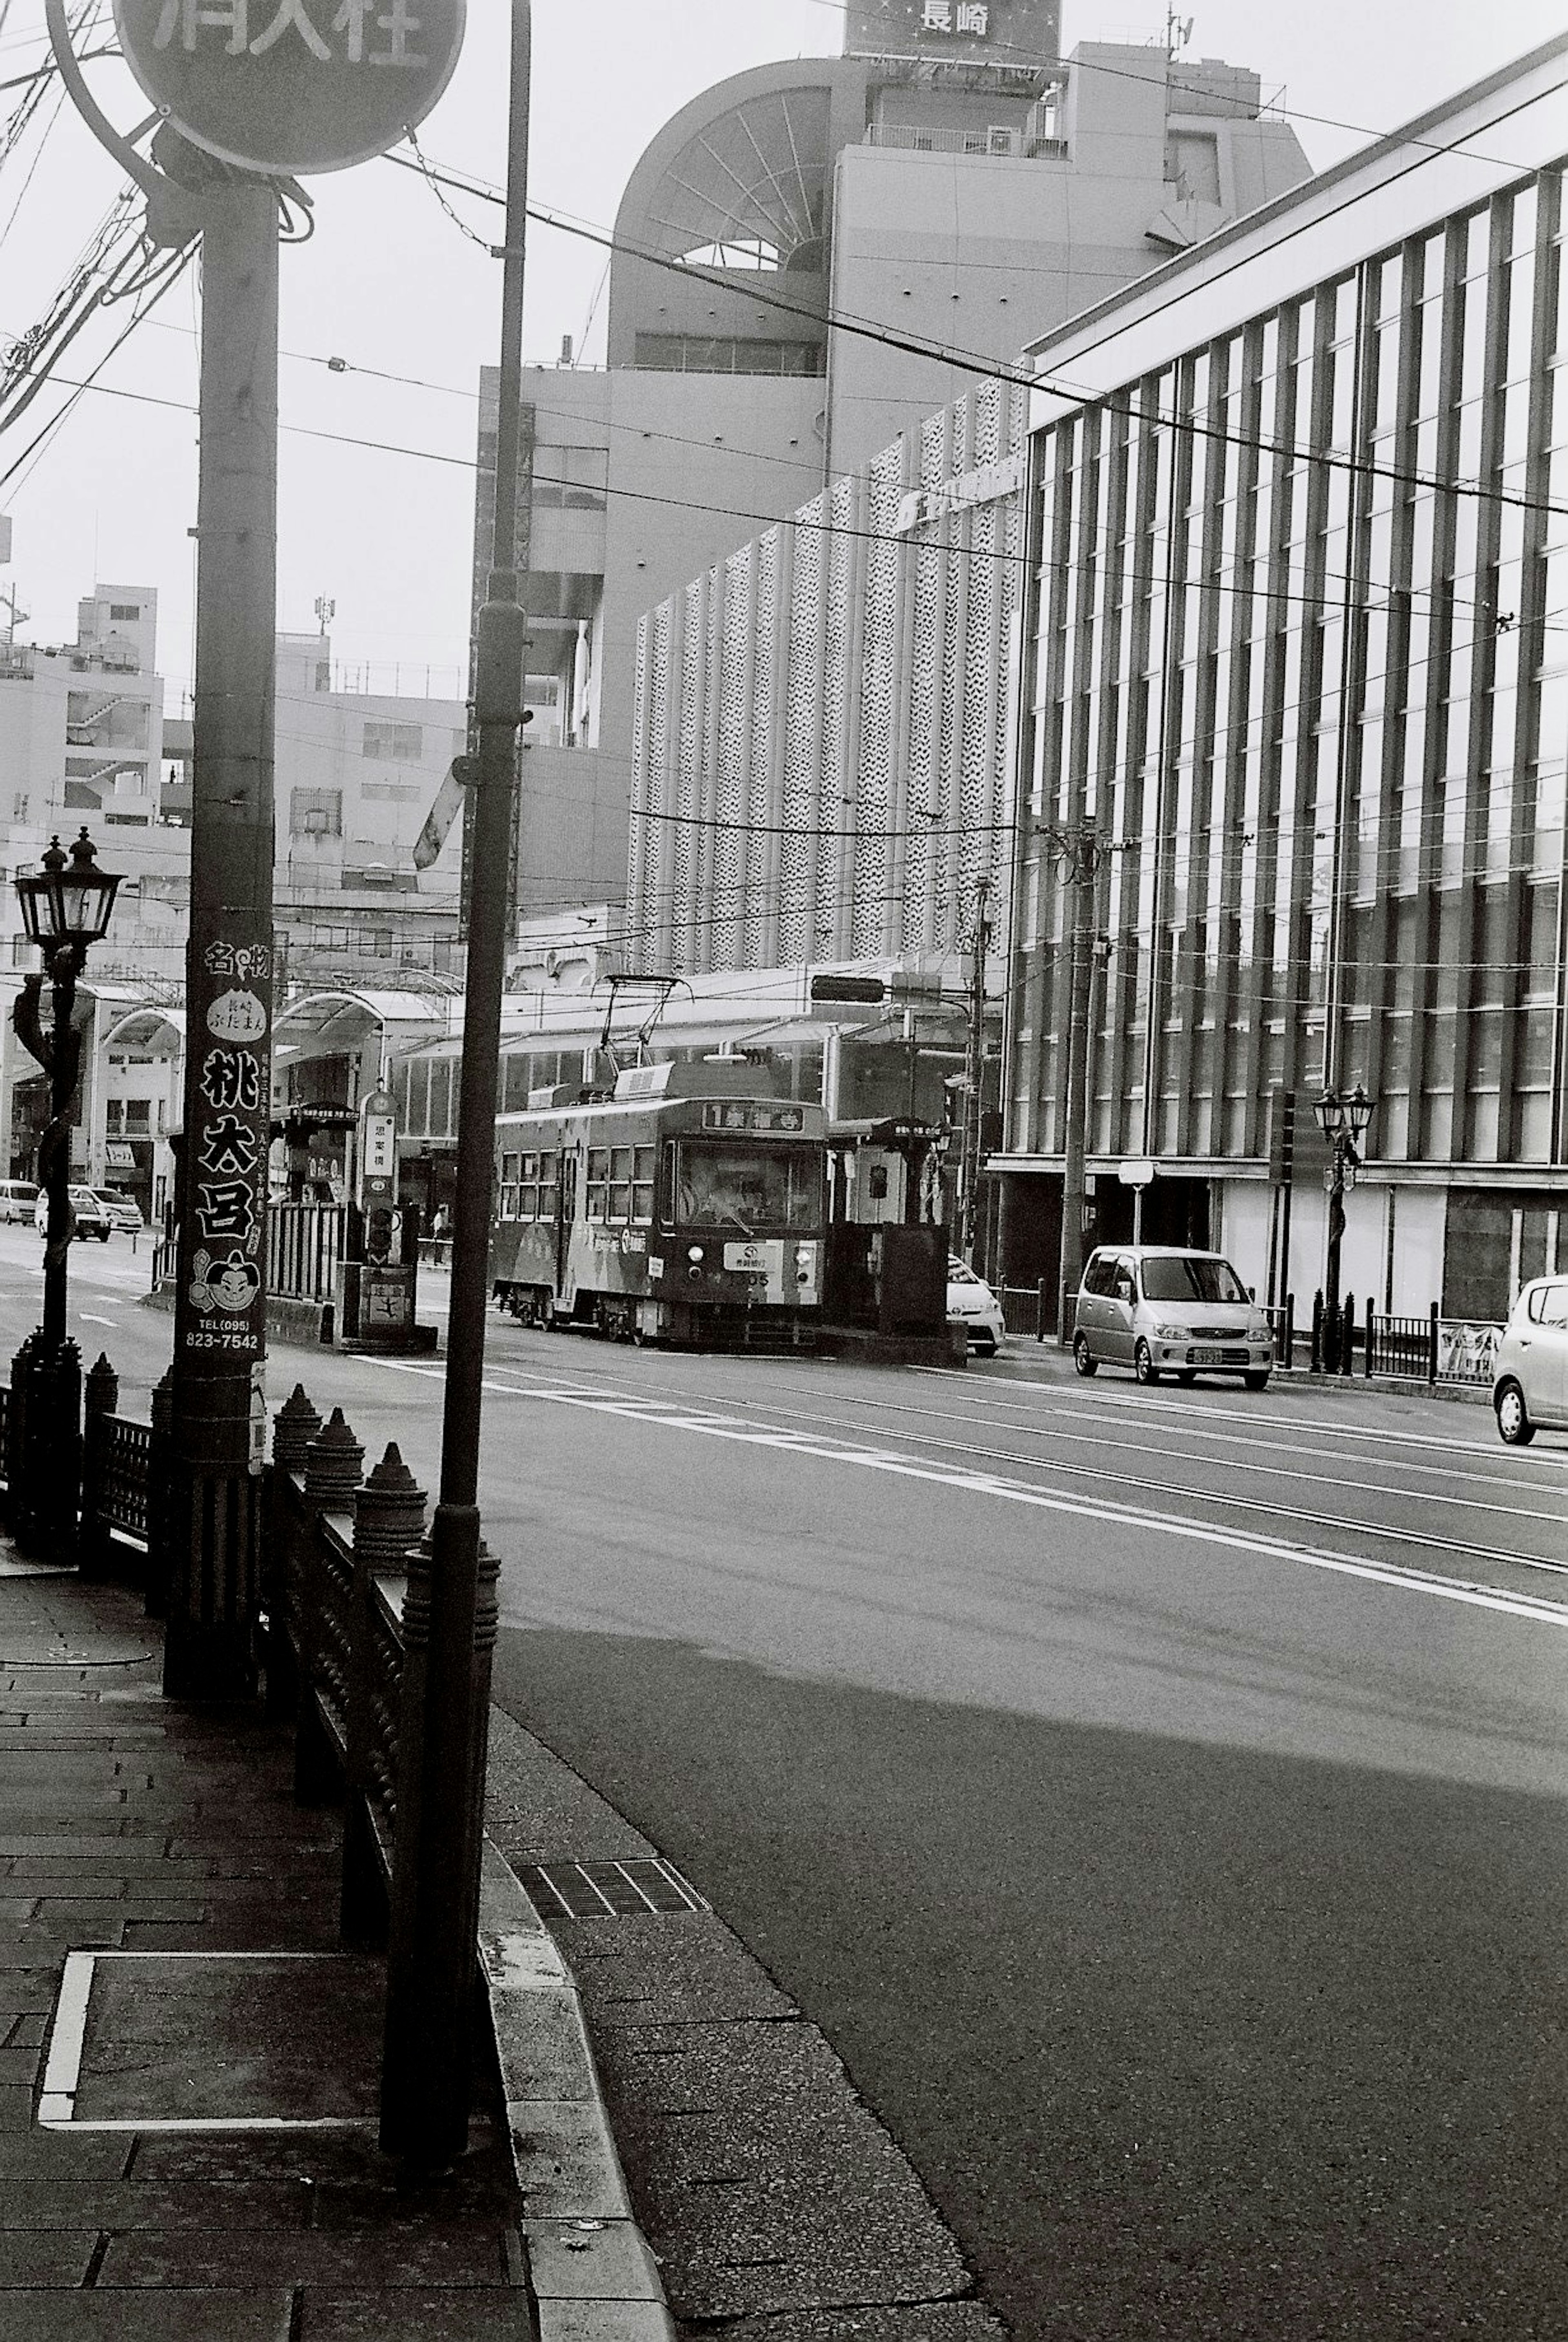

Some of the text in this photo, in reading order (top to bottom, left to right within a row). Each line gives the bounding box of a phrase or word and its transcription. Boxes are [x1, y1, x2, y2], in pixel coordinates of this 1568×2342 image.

[920, 0, 988, 36] 長崎
[209, 1014, 264, 1031] ぶたまん
[712, 1105, 722, 1127] 1
[199, 1319, 249, 1332] TEL(095)
[186, 1332, 258, 1349] 823-7542
